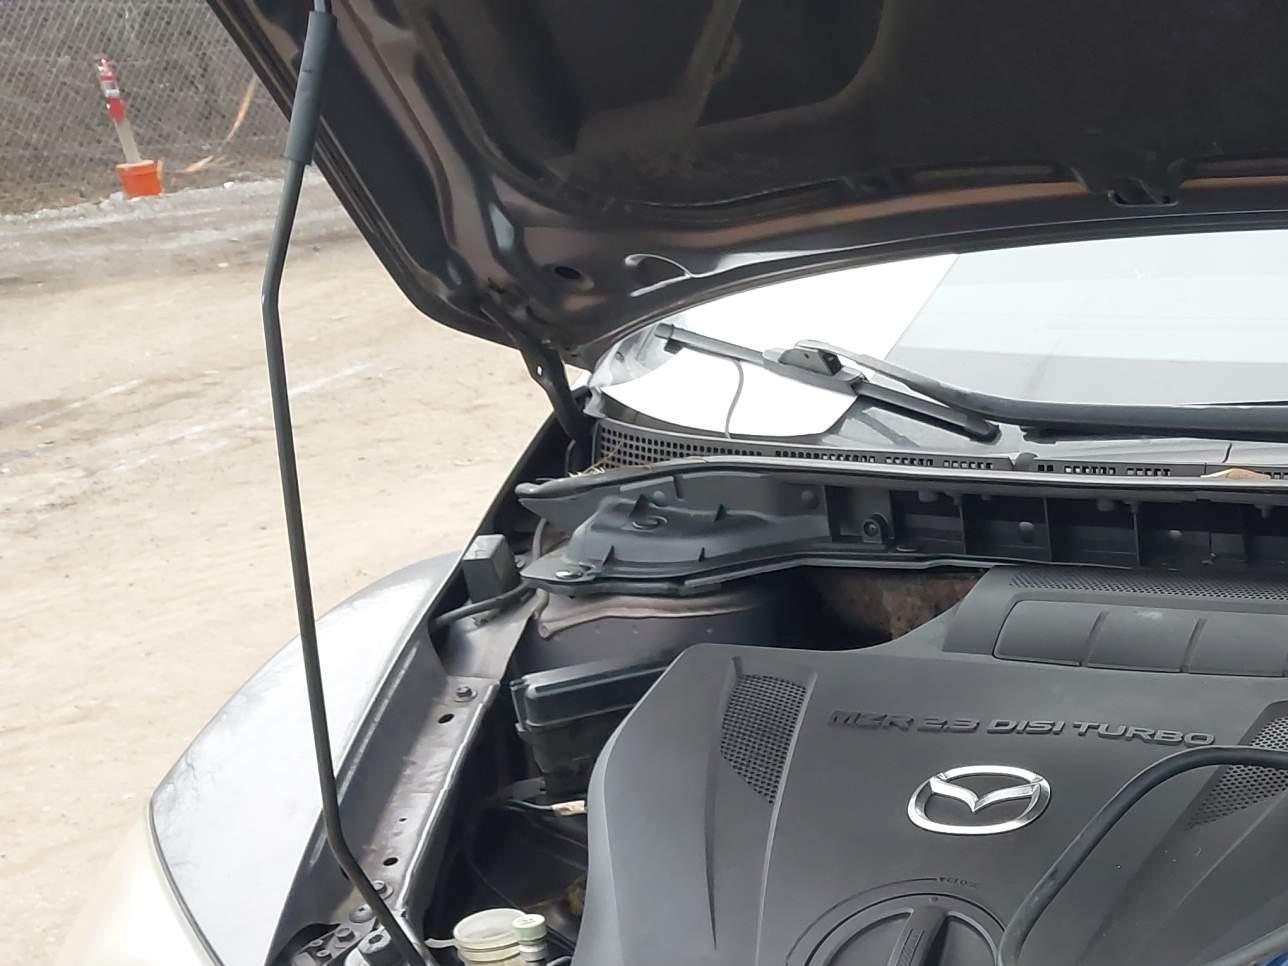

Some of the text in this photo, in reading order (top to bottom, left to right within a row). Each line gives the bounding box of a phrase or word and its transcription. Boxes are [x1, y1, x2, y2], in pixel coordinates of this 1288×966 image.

[829, 710, 1216, 748] MZR 2.3 DISI TURBO
